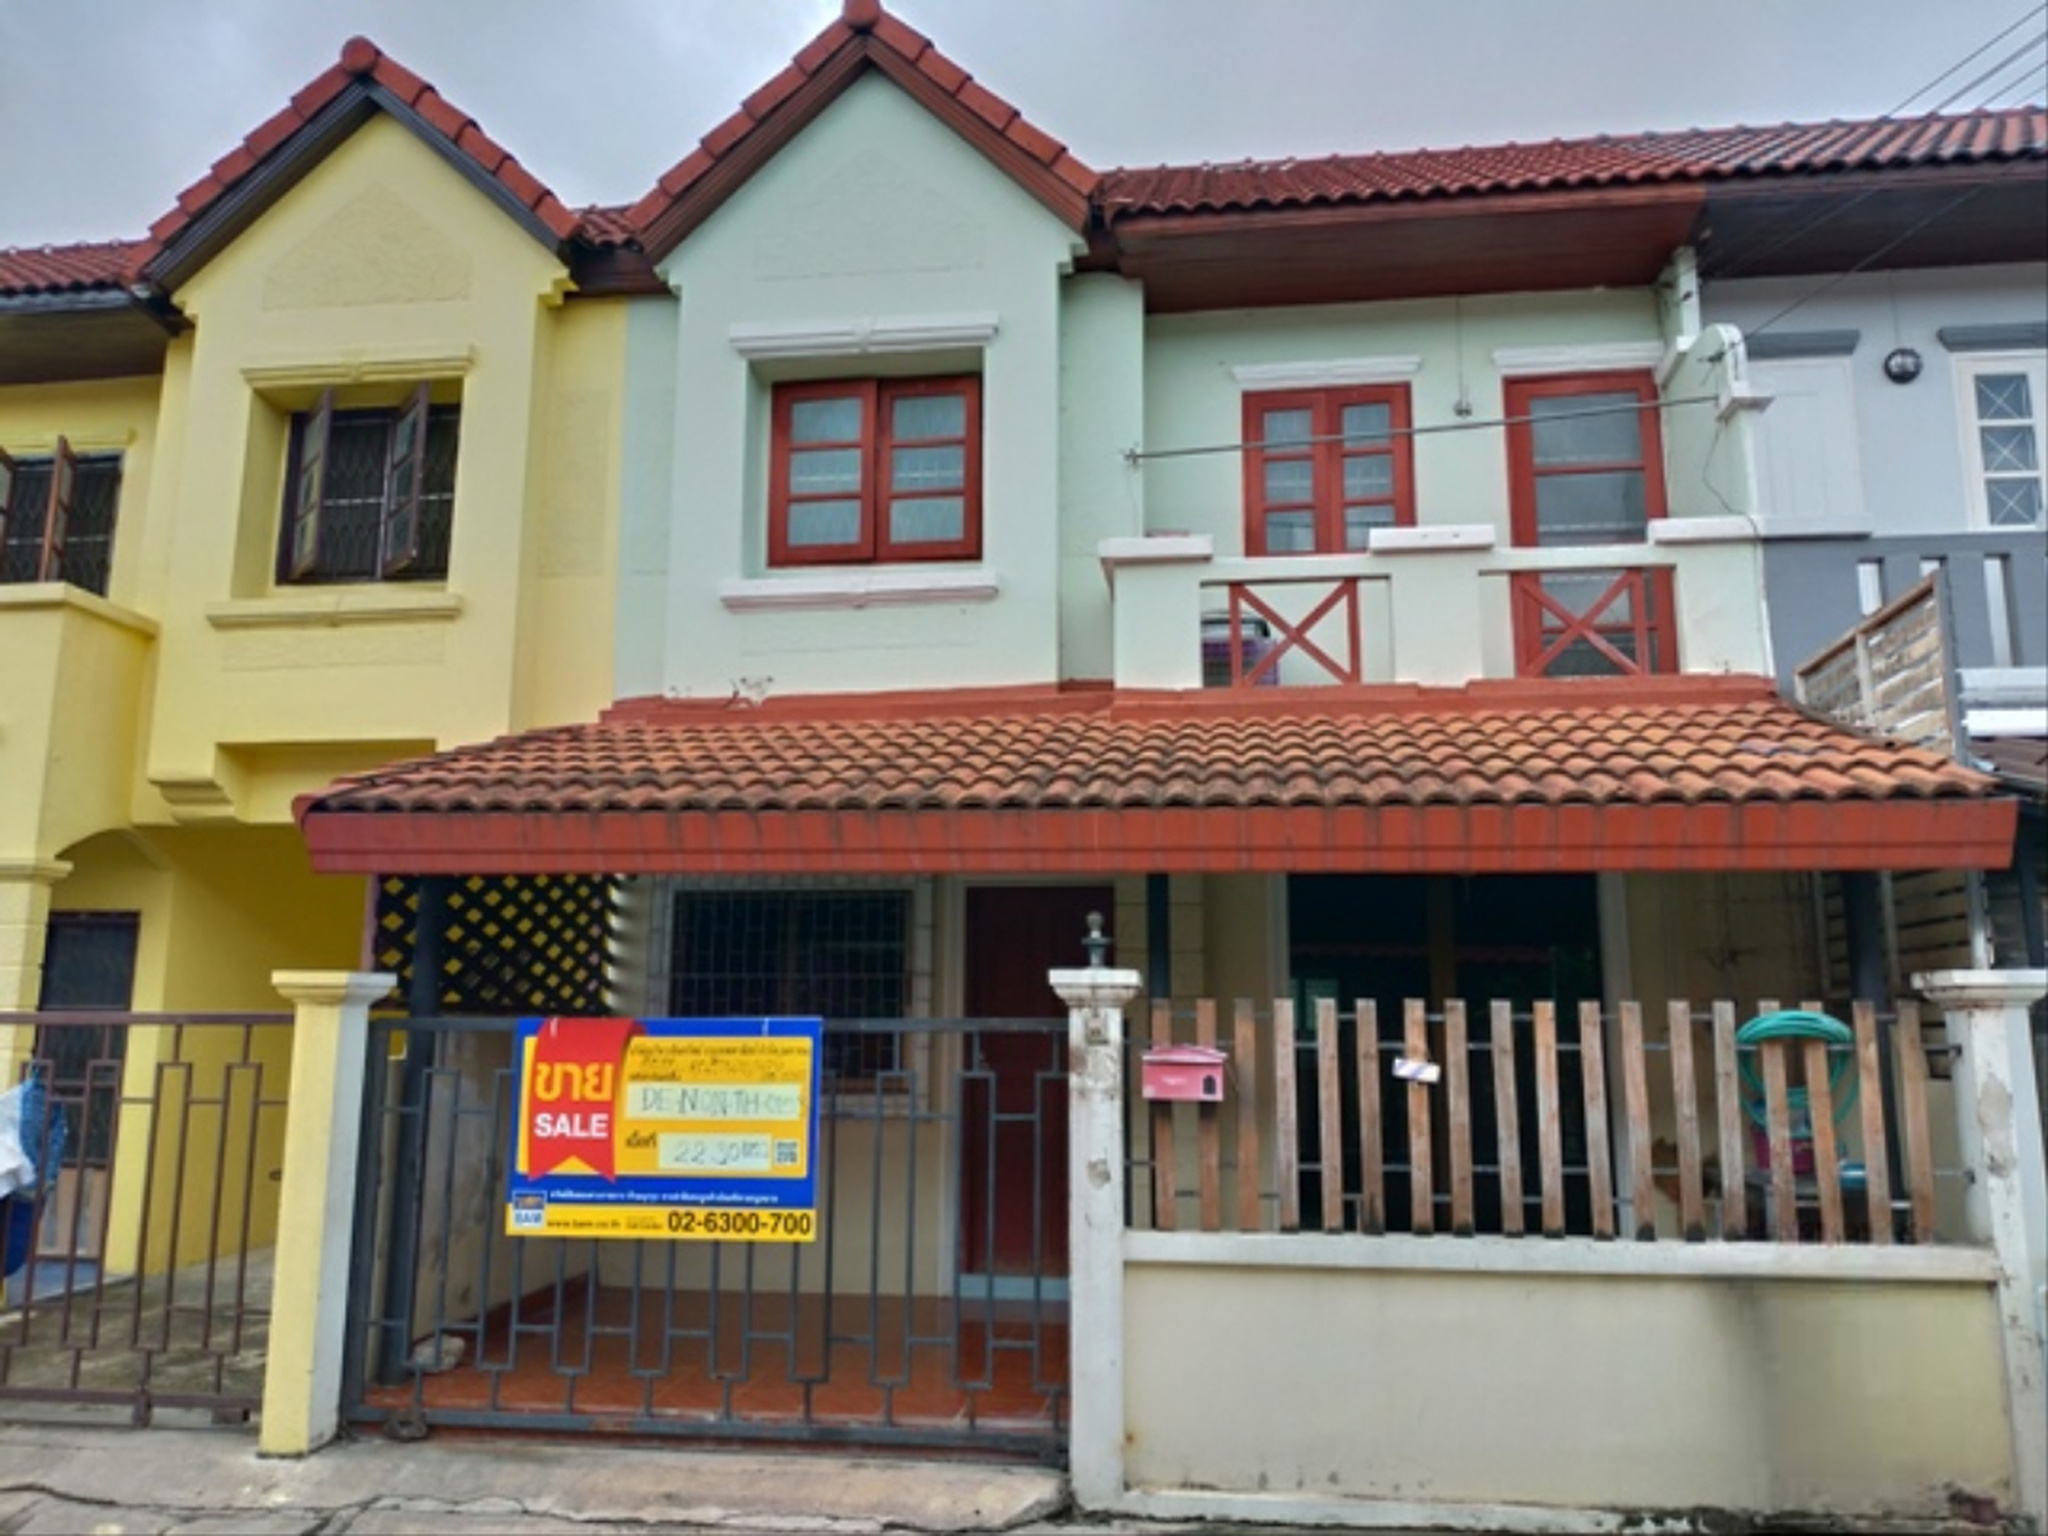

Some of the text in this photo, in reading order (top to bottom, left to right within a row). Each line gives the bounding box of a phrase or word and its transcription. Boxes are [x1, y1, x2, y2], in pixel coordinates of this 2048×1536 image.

[535, 1062, 614, 1102] ขาย
[534, 1112, 609, 1139] SALE
[667, 1211, 812, 1235] 02-6300-700
